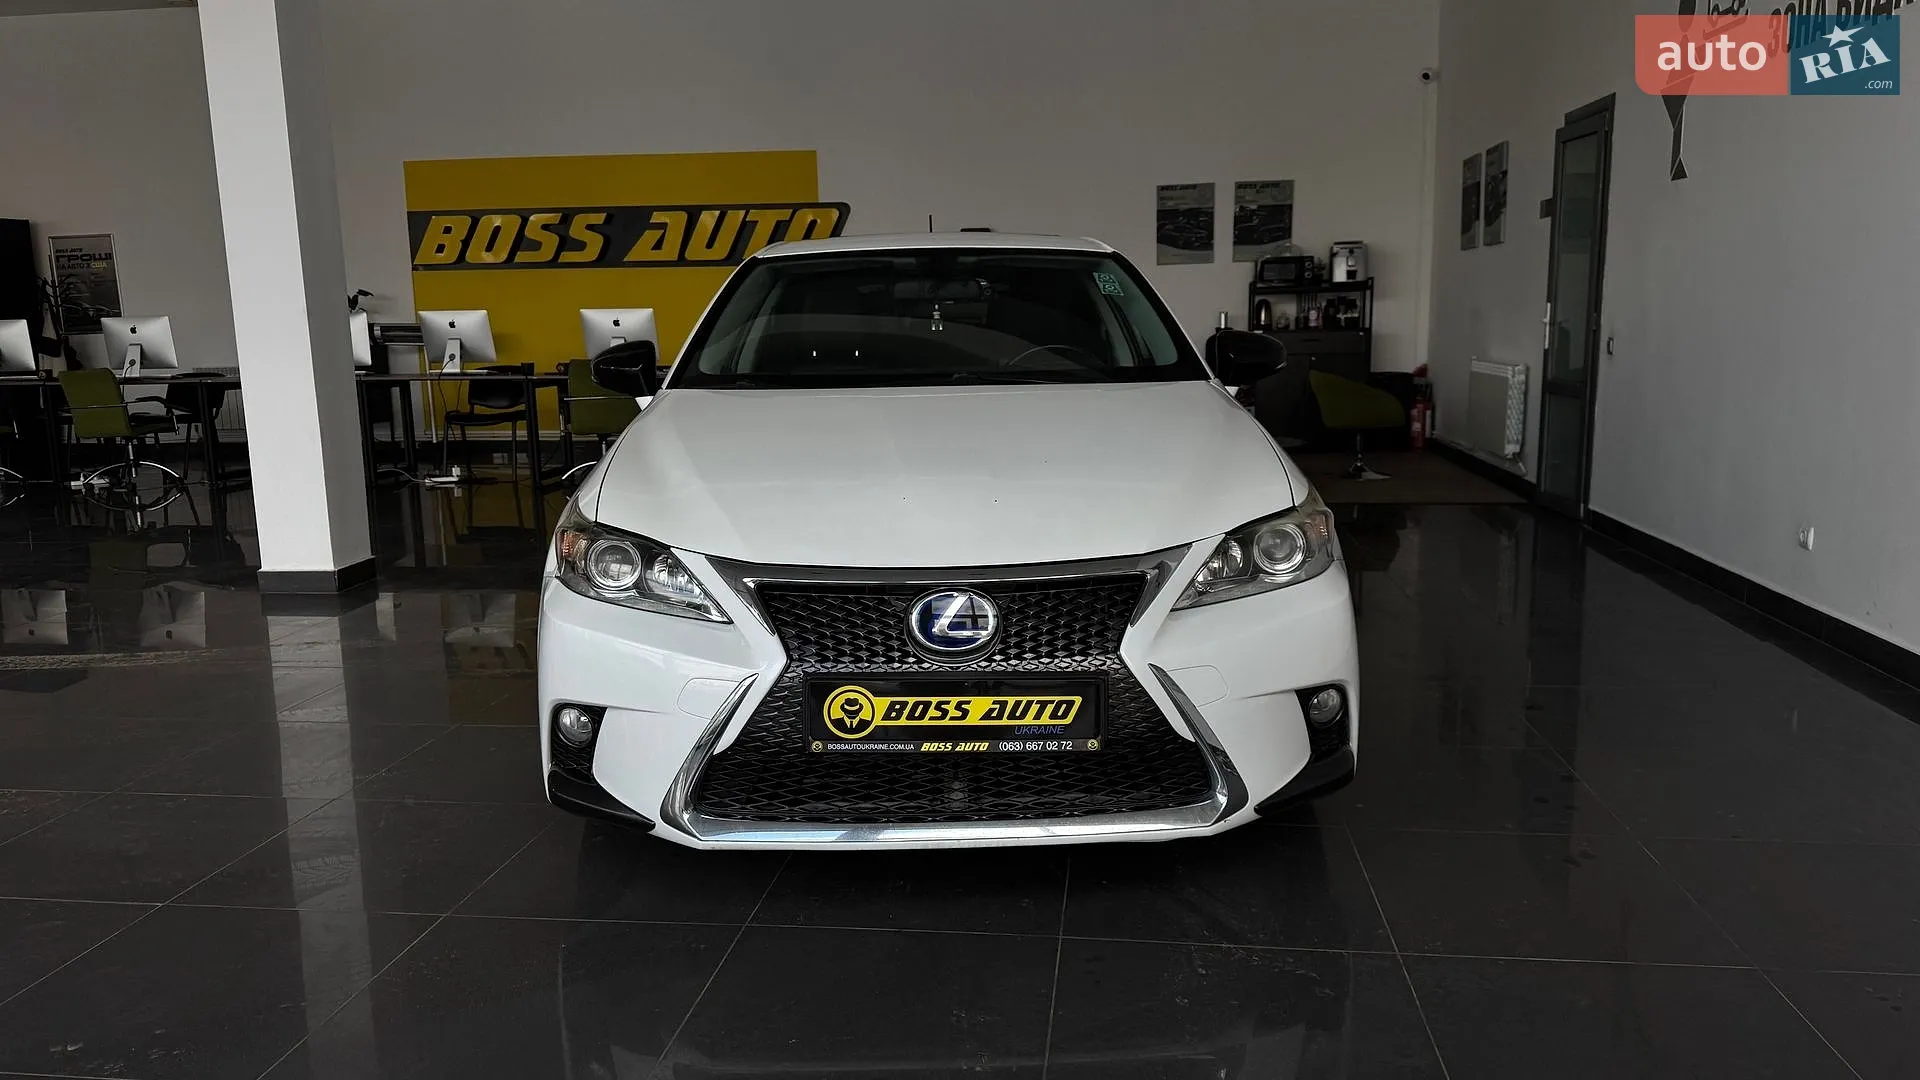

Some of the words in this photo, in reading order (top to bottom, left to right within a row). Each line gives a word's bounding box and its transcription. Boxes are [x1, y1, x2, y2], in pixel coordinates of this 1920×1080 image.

[413, 213, 607, 266] BOSS
[623, 207, 840, 263] AUTO
[880, 700, 973, 721] BOSS
[978, 700, 1077, 721] AUTO
[1015, 725, 1066, 735] UKRAINE
[827, 743, 915, 751] BOSSAUTOUKRAINE.COM.UA
[920, 742, 953, 752] BOSS
[955, 742, 990, 752] AUTO
[999, 741, 1024, 752] (063)
[1026, 741, 1042, 751] 667
[1046, 741, 1058, 751] 02
[1060, 741, 1073, 751] 72
